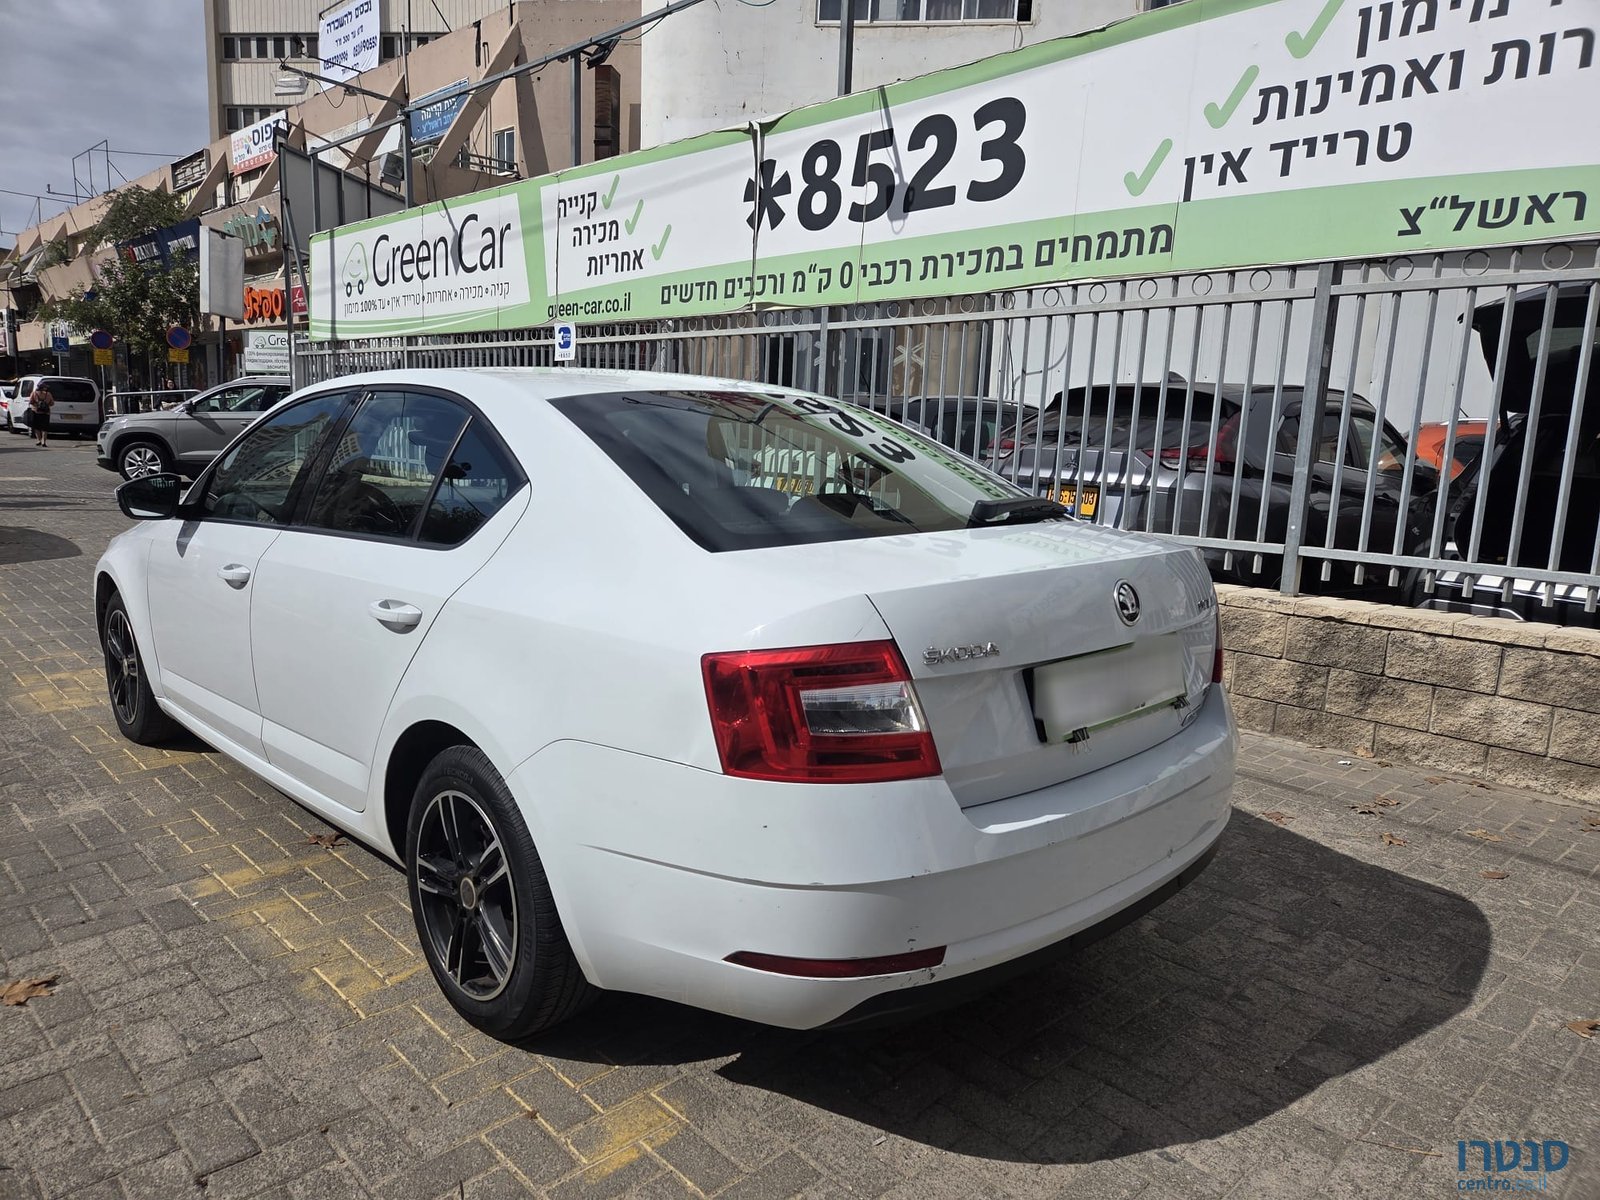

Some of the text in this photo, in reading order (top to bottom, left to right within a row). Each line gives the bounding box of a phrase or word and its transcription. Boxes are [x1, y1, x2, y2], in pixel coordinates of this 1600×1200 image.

[326, 11, 353, 34] להשכרה
[1252, 49, 1465, 126] ואמינות
[1182, 121, 1413, 203] טרייד אין
[557, 191, 598, 220] קנייה
[1397, 190, 1587, 237] ראשל"צ
[372, 213, 511, 288] Green Car
[572, 219, 620, 247] מכירה
[586, 248, 645, 277] אחריות
[660, 223, 1174, 306] מתמחים במכירת רכבי 0 ק"מ ורכבים חדשים
[344, 282, 510, 317] קניה מכירה אחריות טרייד אין עד 100% מימון
